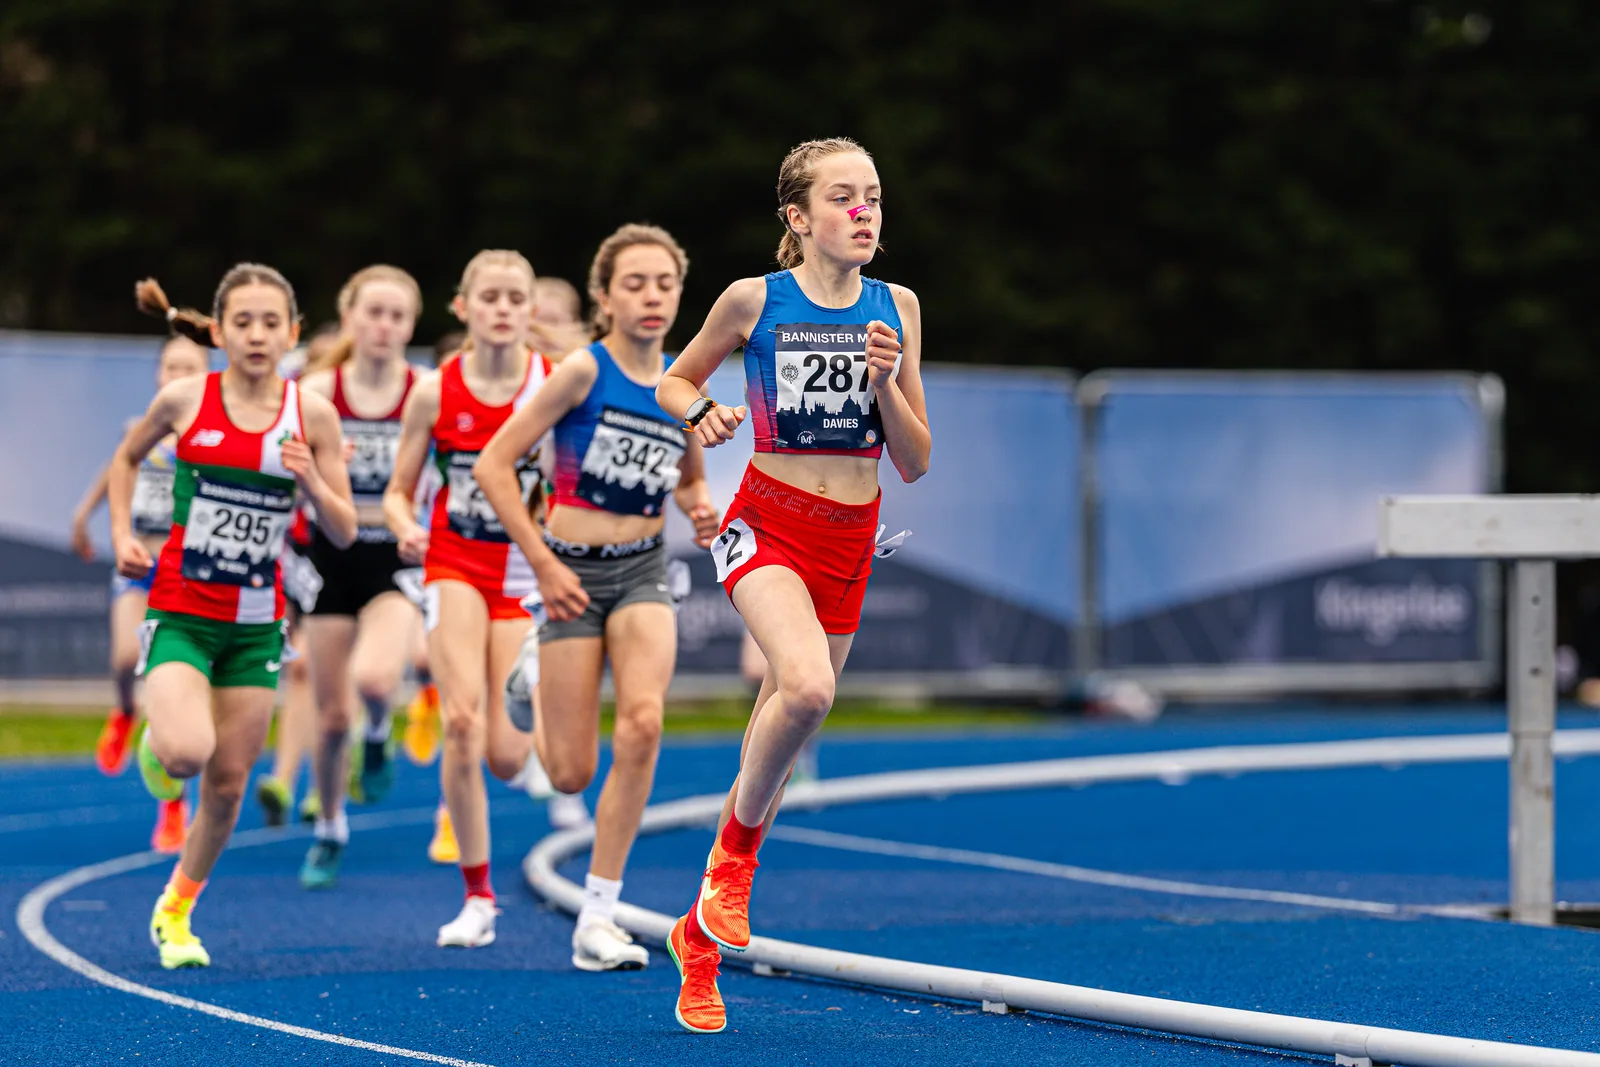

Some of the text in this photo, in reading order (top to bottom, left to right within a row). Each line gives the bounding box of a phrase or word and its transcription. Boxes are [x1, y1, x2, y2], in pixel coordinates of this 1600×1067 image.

[782, 332, 854, 344] BANNISTER
[803, 353, 869, 393] 287
[823, 418, 859, 429] DAVIES
[612, 437, 668, 477] 342
[743, 471, 874, 524] NIKE PRO
[211, 508, 272, 545] 295
[600, 536, 656, 558] NIKE
[719, 527, 743, 567] 2
